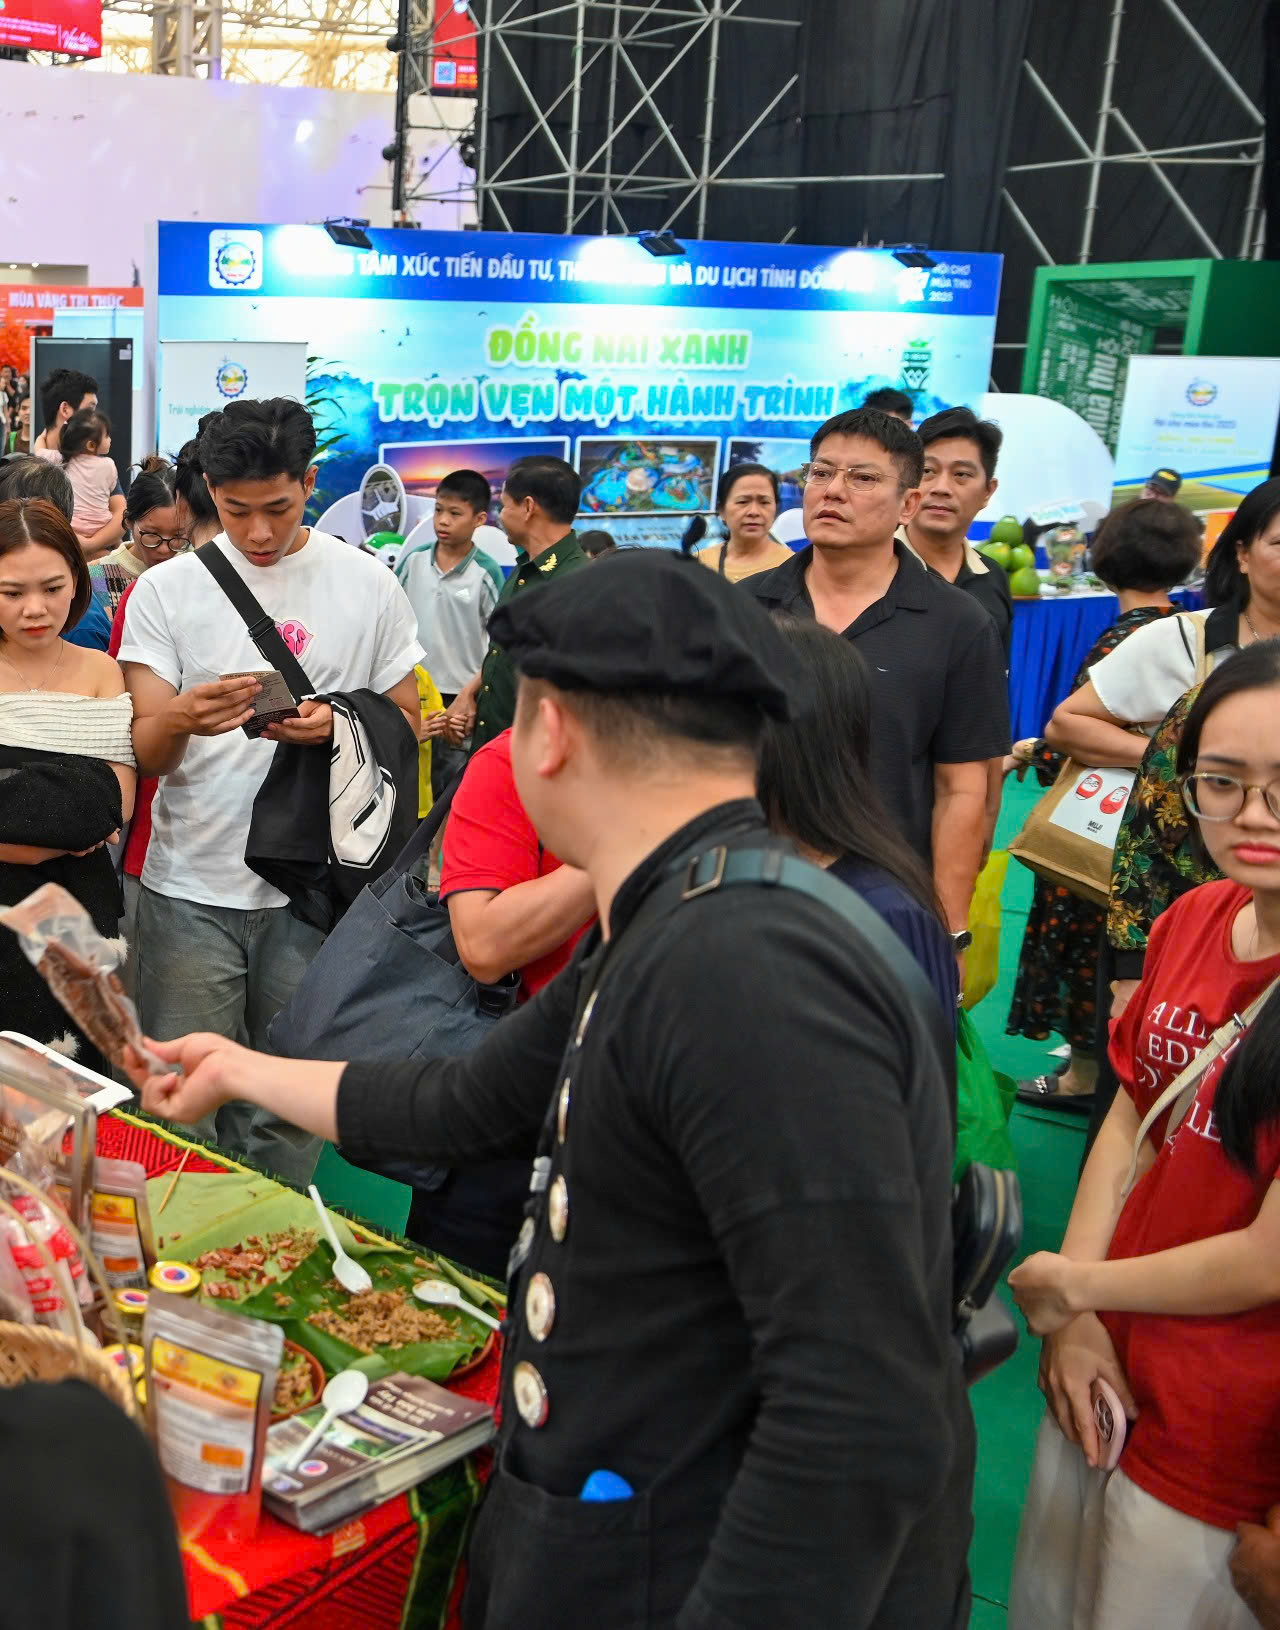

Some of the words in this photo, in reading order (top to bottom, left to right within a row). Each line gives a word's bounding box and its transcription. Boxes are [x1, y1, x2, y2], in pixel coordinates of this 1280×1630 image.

[402, 251, 441, 276] XÚC
[446, 251, 483, 279] TIẾN
[487, 252, 525, 279] ĐẦU
[696, 265, 719, 286] DU
[723, 266, 758, 288] LỊCH
[761, 264, 796, 288] TỈNH
[487, 315, 582, 363] ĐỒNG
[592, 333, 649, 364] NAI
[658, 334, 749, 366] XANH
[377, 382, 474, 423] TRỌN
[485, 382, 554, 423] VẸN
[565, 378, 638, 423] MỘT
[648, 376, 736, 416] HÀNH
[744, 378, 835, 417] TRÌNH
